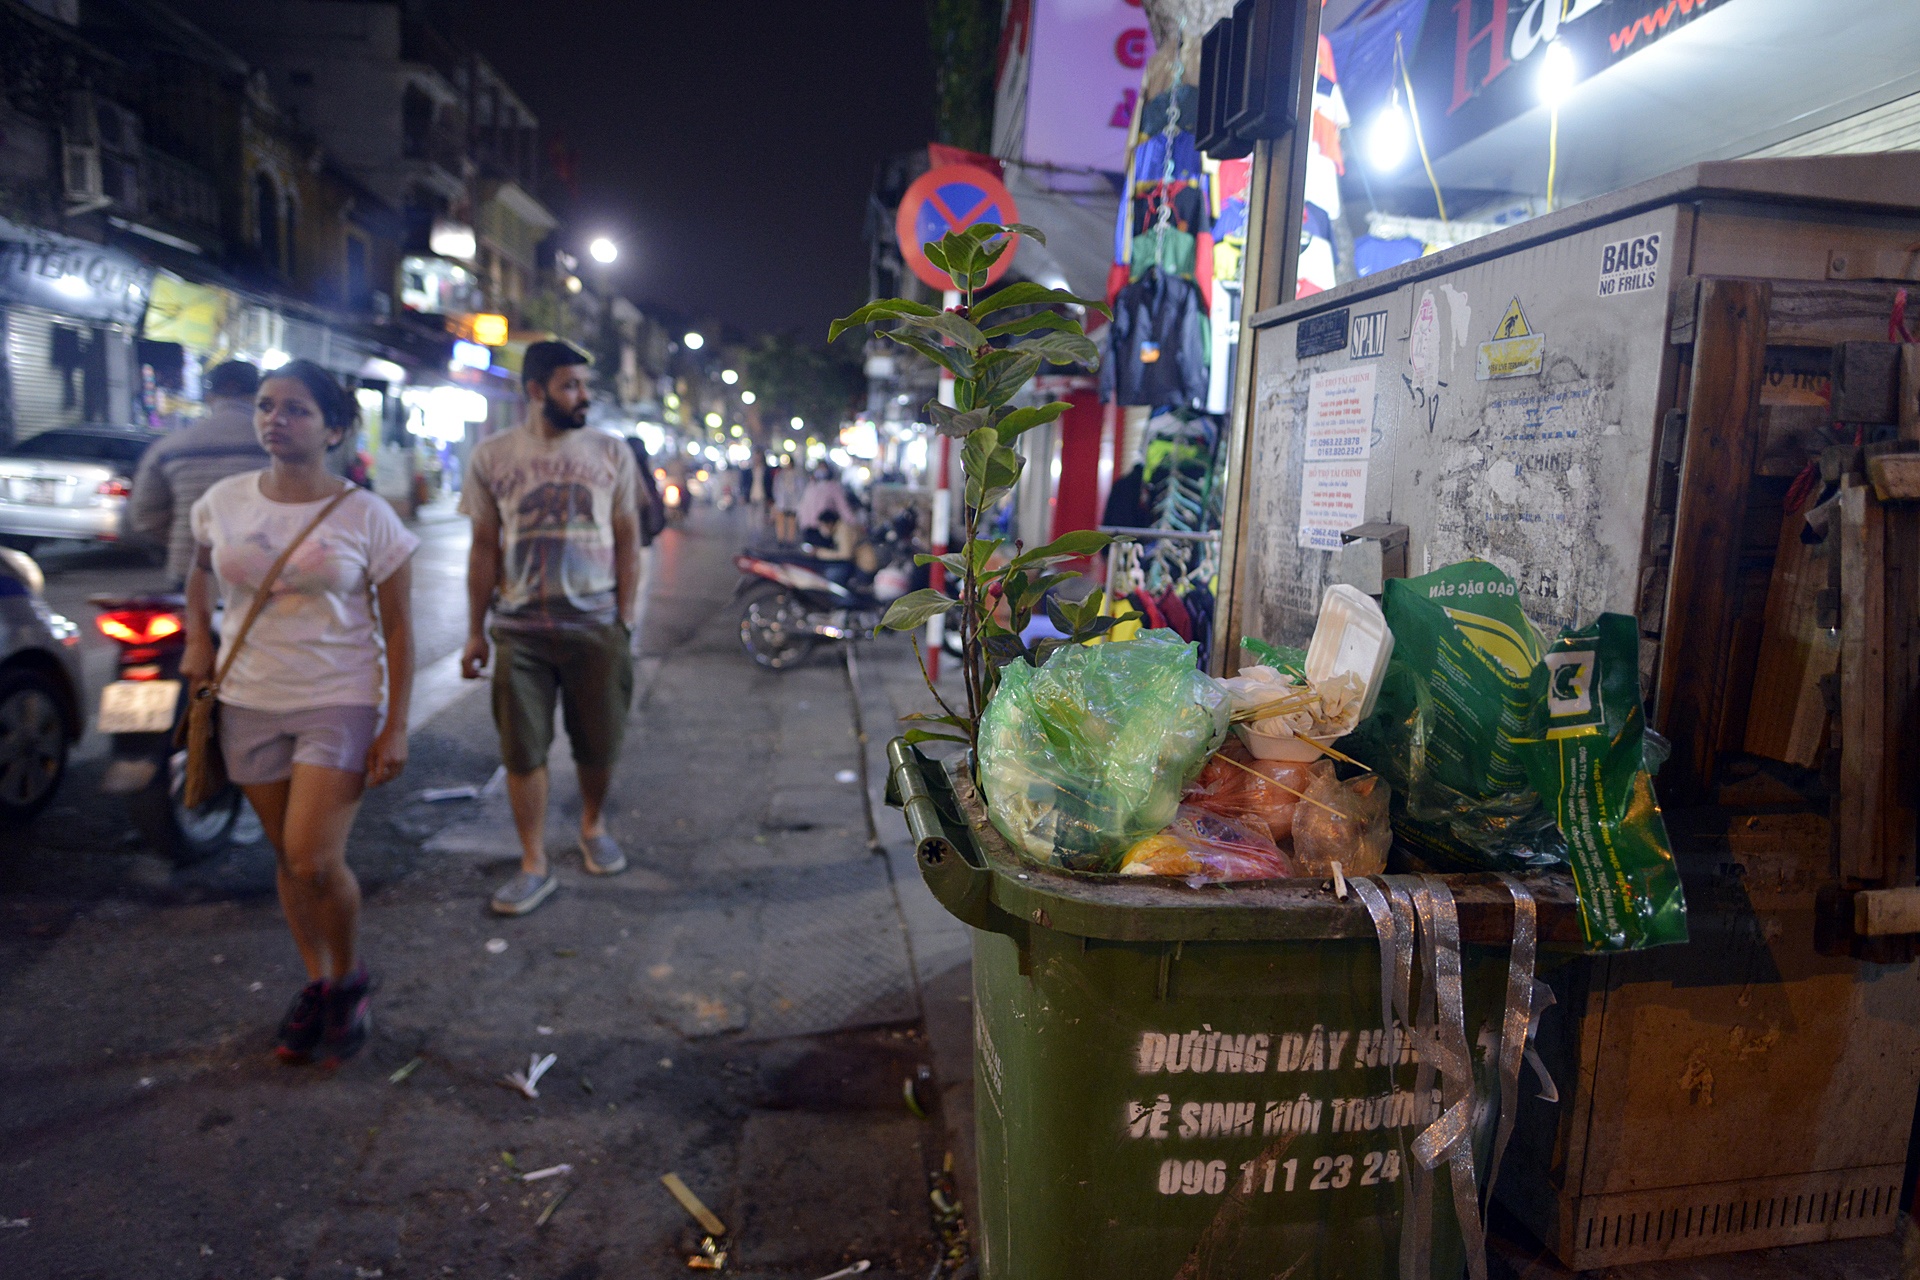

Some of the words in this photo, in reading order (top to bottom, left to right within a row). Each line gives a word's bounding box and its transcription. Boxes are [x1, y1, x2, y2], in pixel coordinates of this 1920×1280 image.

[1602, 235, 1659, 275] BAGS
[1599, 279, 1615, 295] NO
[1618, 271, 1655, 292] FRILLS
[1352, 313, 1387, 358] SPAM
[1178, 1101, 1256, 1138] SINH
[1262, 1092, 1323, 1137] MÔI
[1158, 1159, 1227, 1195] 096
[1239, 1158, 1298, 1194] 111
[1309, 1153, 1354, 1190] 23
[1360, 1149, 1400, 1187] 24
